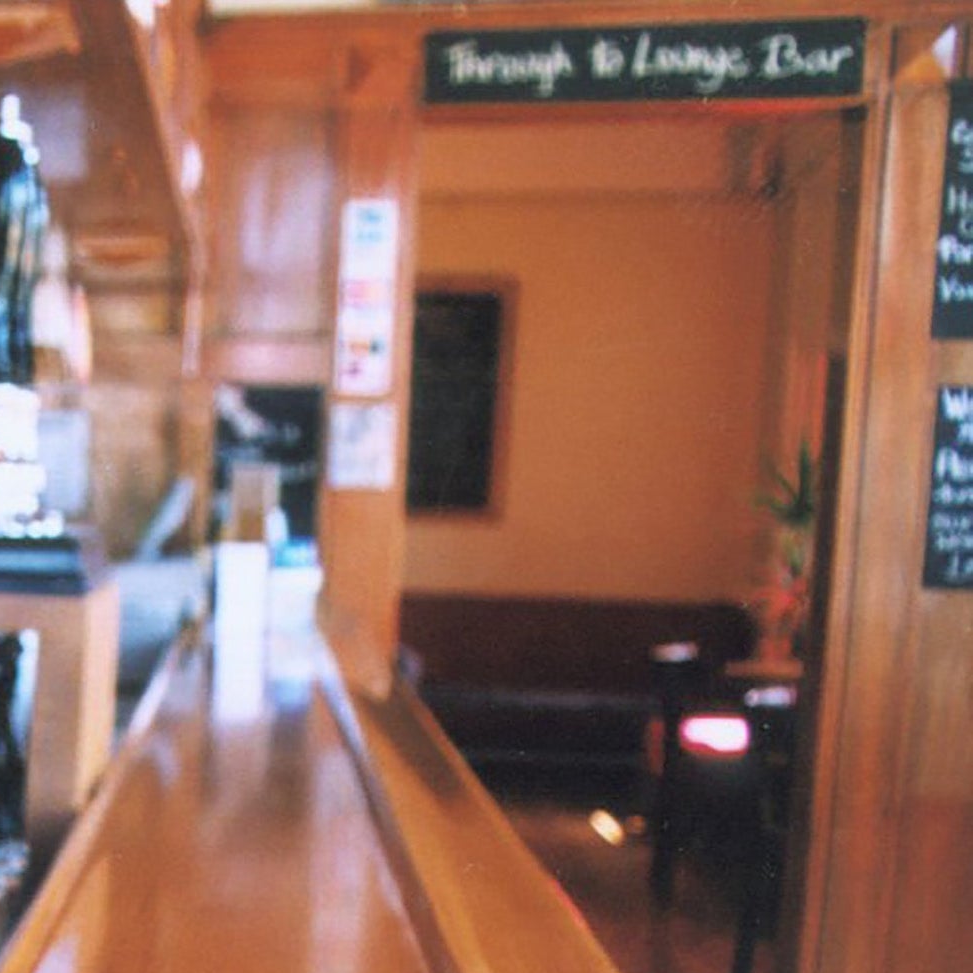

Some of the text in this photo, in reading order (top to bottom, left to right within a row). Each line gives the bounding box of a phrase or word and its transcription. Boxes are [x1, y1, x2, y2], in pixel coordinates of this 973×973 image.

[446, 32, 855, 97] Through to Lounge Bar
